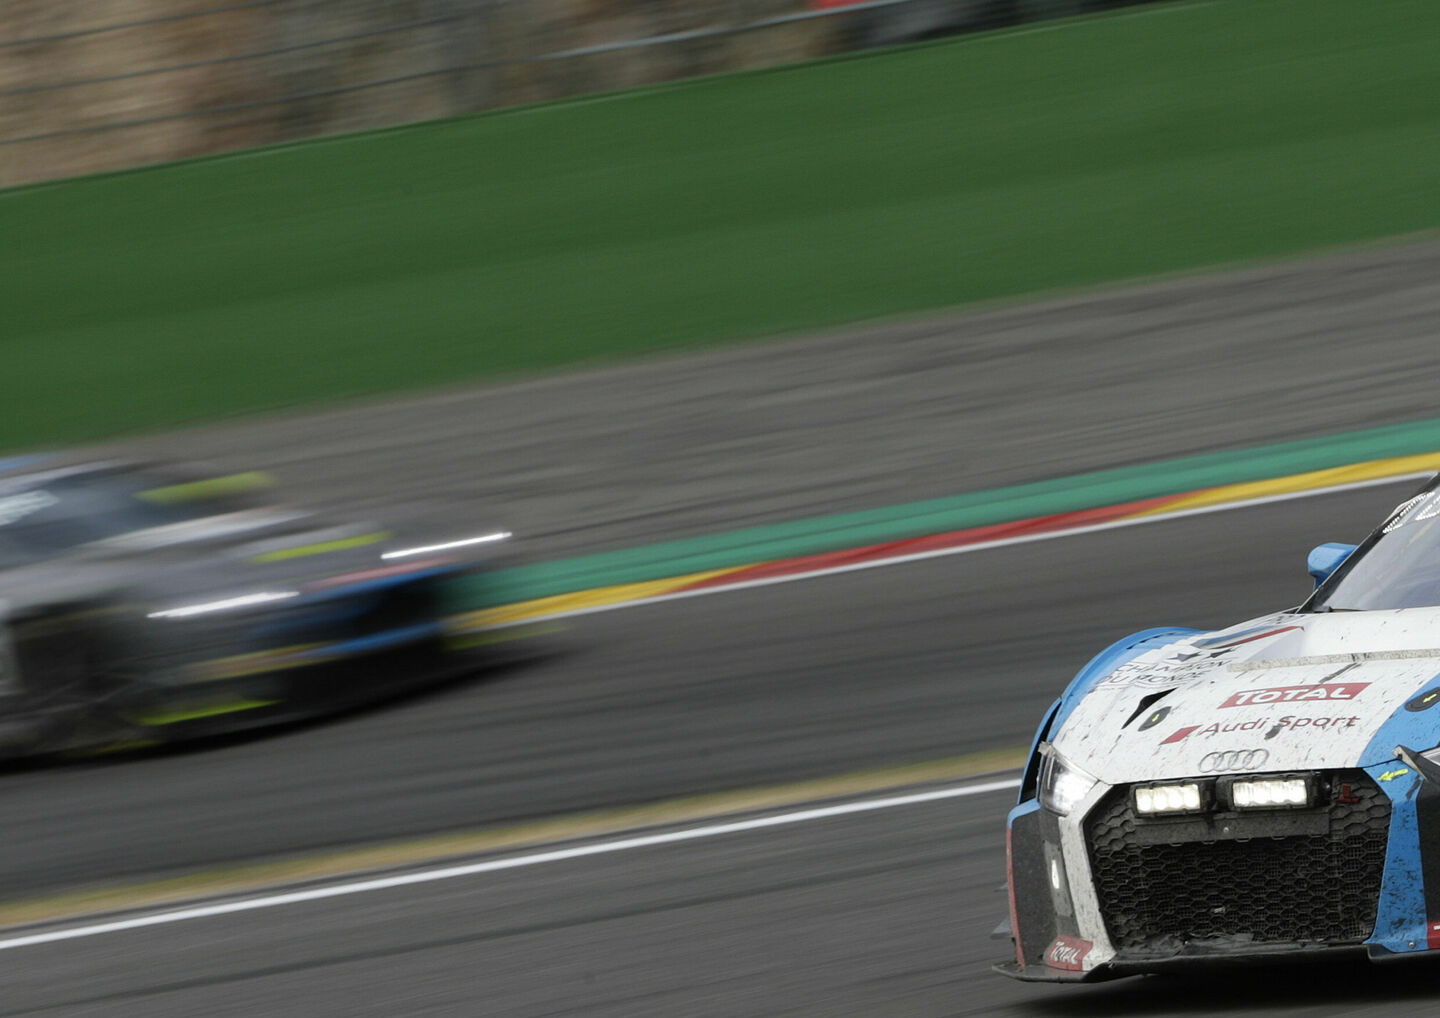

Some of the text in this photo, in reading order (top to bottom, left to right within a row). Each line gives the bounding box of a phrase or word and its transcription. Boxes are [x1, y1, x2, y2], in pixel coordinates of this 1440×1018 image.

[1234, 686, 1353, 706] TOTAL
[1198, 715, 1360, 736] Audi Sport
[1050, 941, 1081, 965] TOTAL
